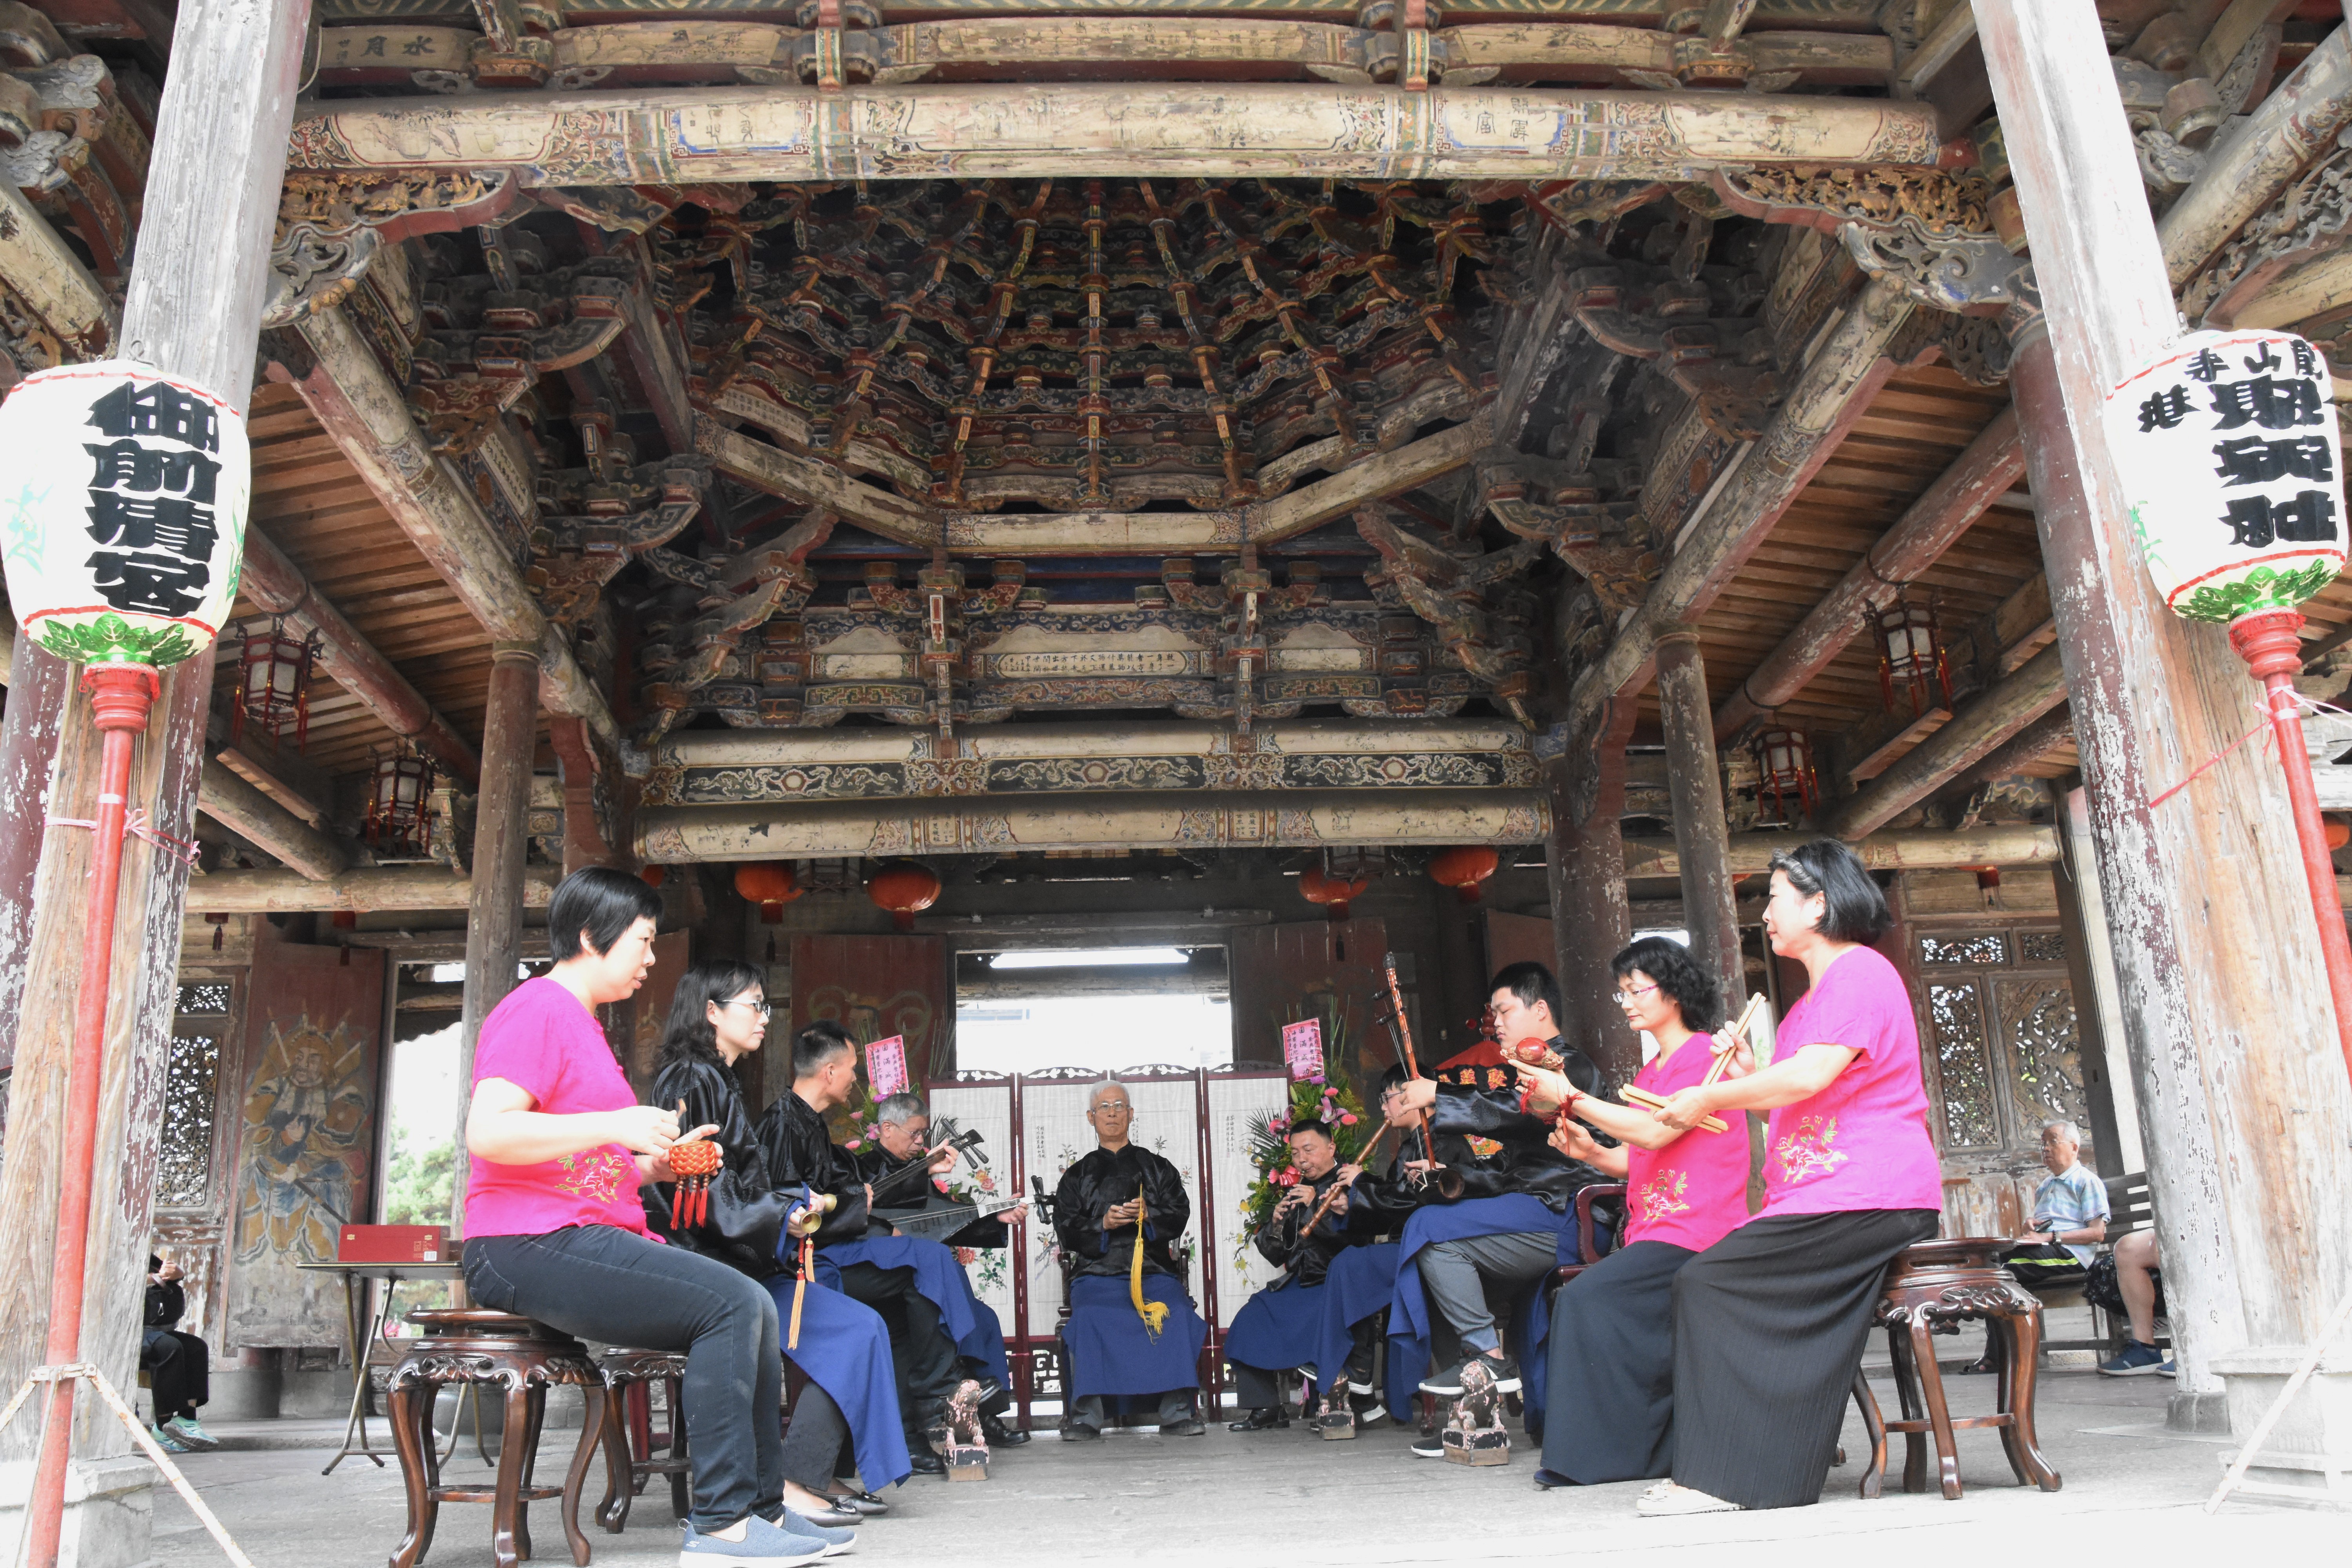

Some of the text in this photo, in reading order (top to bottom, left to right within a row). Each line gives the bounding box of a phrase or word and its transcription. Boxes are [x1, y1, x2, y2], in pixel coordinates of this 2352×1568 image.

[360, 35, 436, 57] 水月
[882, 1044, 894, 1093] 圓滿成功
[1298, 1026, 1310, 1075] 圓滿成功
